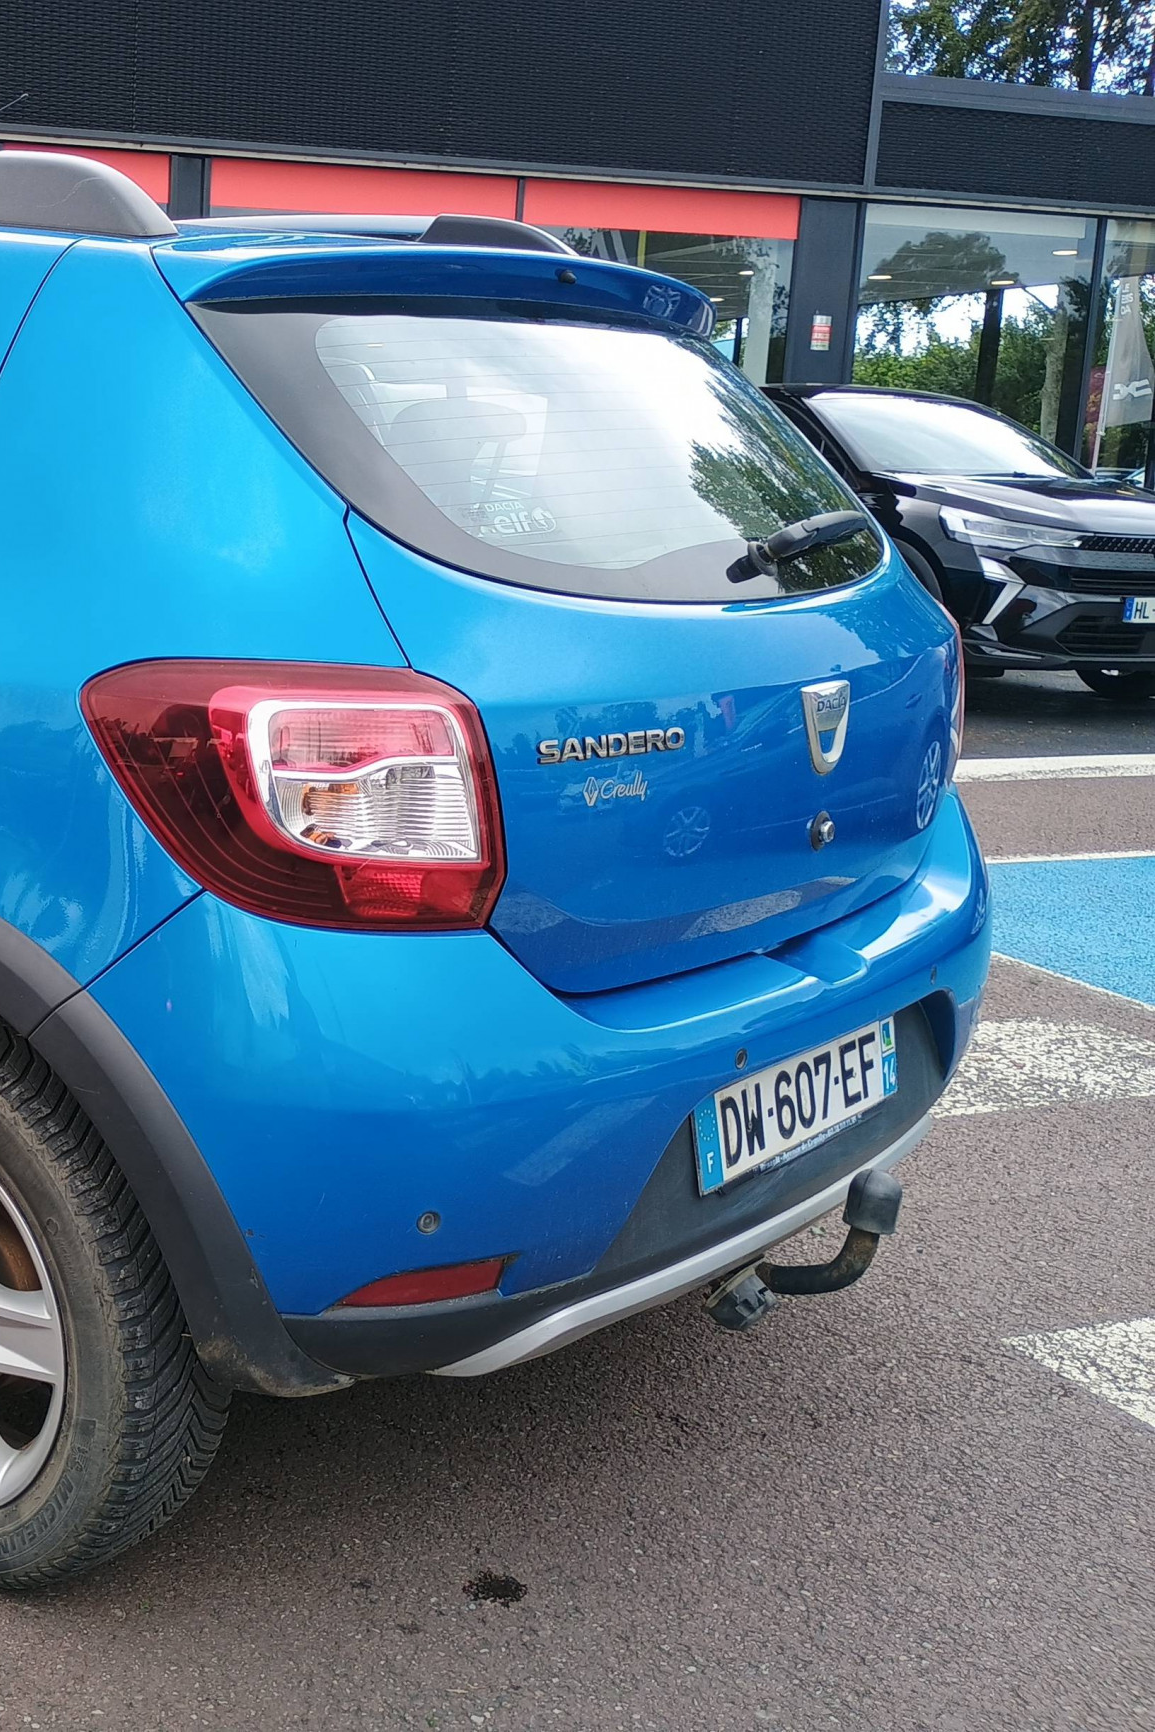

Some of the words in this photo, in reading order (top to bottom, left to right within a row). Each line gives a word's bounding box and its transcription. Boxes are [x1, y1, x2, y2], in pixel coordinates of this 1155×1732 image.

[484, 501, 525, 512] DACIA
[493, 511, 533, 534] elf
[817, 695, 847, 712] DACIA
[536, 726, 685, 765] SANDERO
[719, 1031, 876, 1169] DW-607-EF
[706, 1152, 715, 1174] F
